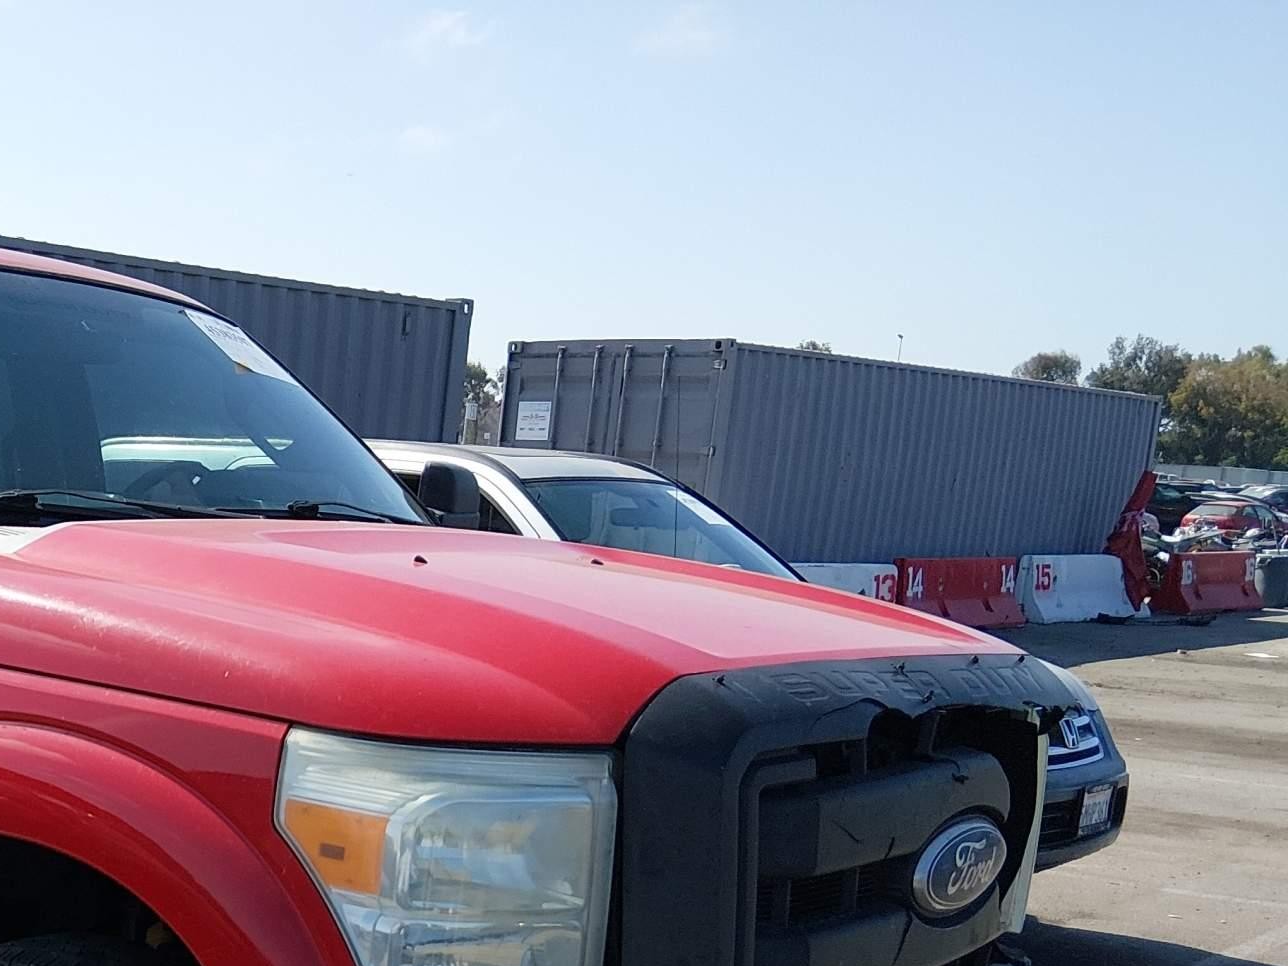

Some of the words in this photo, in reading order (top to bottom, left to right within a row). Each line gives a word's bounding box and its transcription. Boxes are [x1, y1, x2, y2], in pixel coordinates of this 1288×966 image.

[873, 574, 896, 603] 13
[907, 565, 924, 600] 14
[1000, 564, 1014, 594] 14
[1035, 563, 1052, 593] 15
[769, 670, 953, 704] SUPER
[946, 838, 997, 896] Ford
